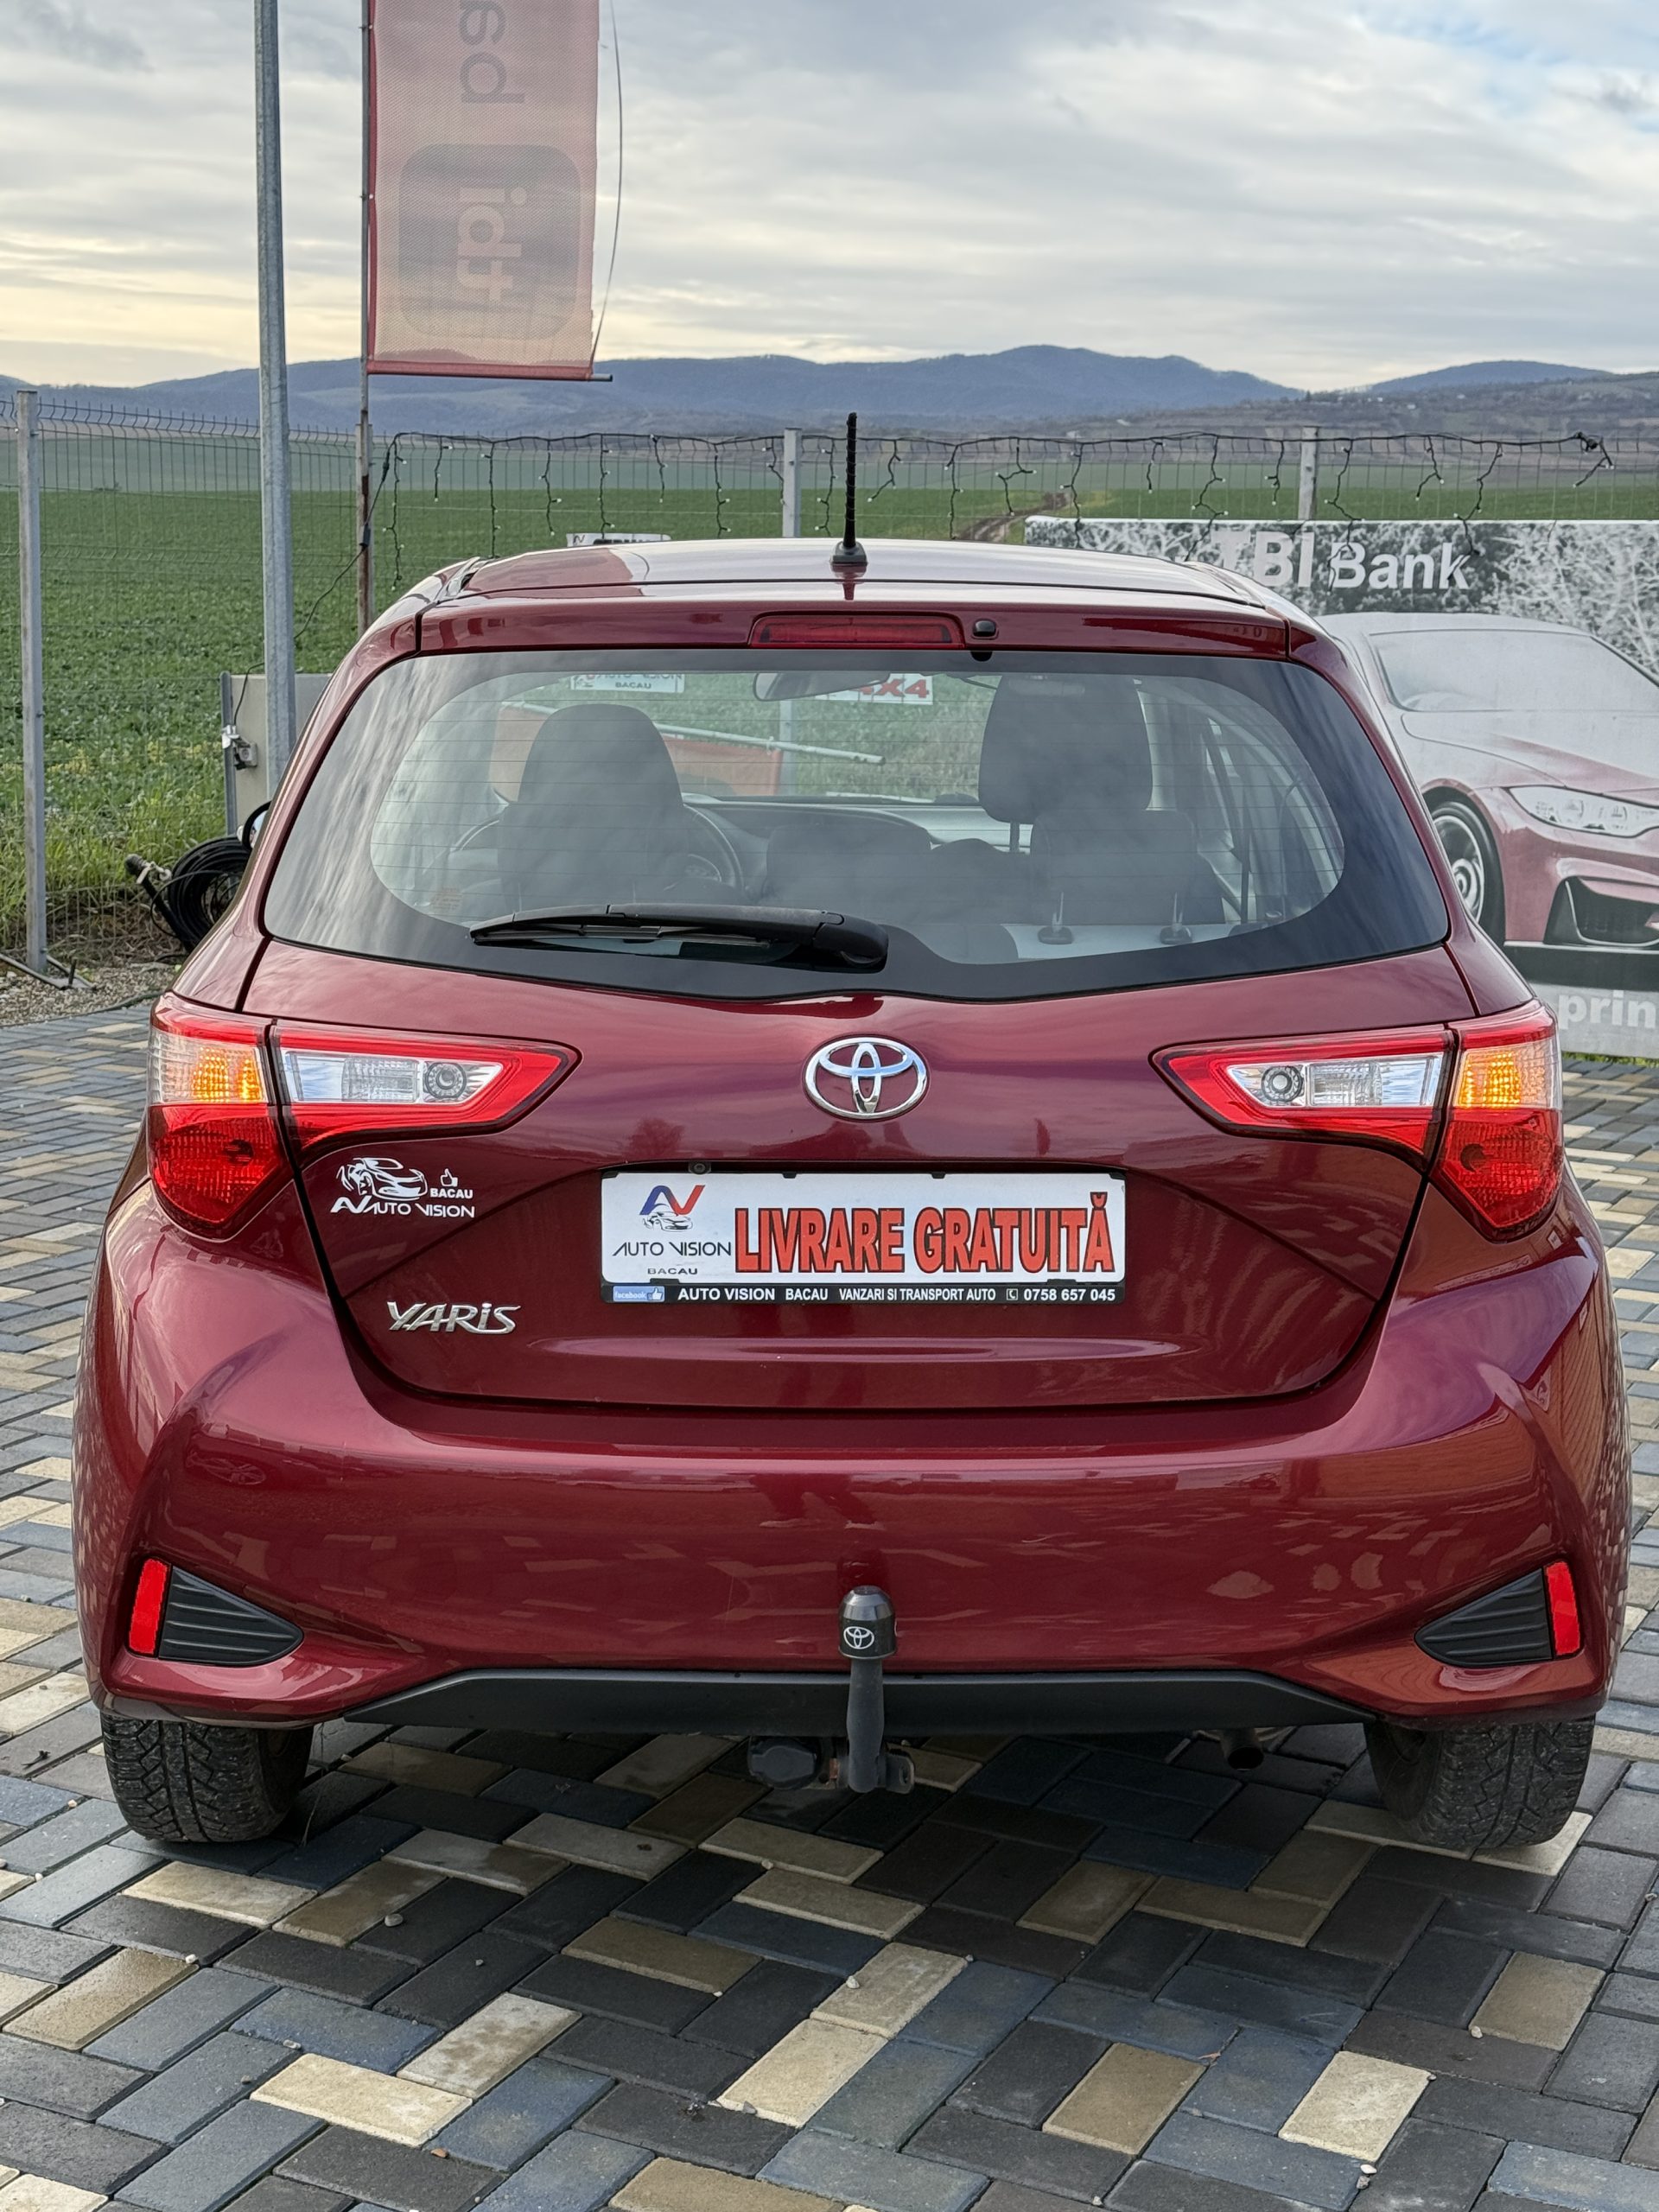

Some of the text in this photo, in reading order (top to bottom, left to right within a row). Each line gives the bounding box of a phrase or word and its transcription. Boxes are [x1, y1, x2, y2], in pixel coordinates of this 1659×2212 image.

[1211, 531, 1471, 589] TBI Bank
[854, 678, 930, 698] X4
[1558, 989, 1656, 1030] prin
[429, 1188, 474, 1198] BACAU
[363, 1202, 412, 1215] AUTO
[415, 1203, 475, 1218] VISION
[735, 1192, 1116, 1274] LIVRARE GRATUITĂ
[612, 1242, 732, 1256] AUTO VISION
[615, 1287, 1116, 1301] facebook AUTO VISION BACAU VANZARI SI TRANSPORT AUTO 0758 657 045
